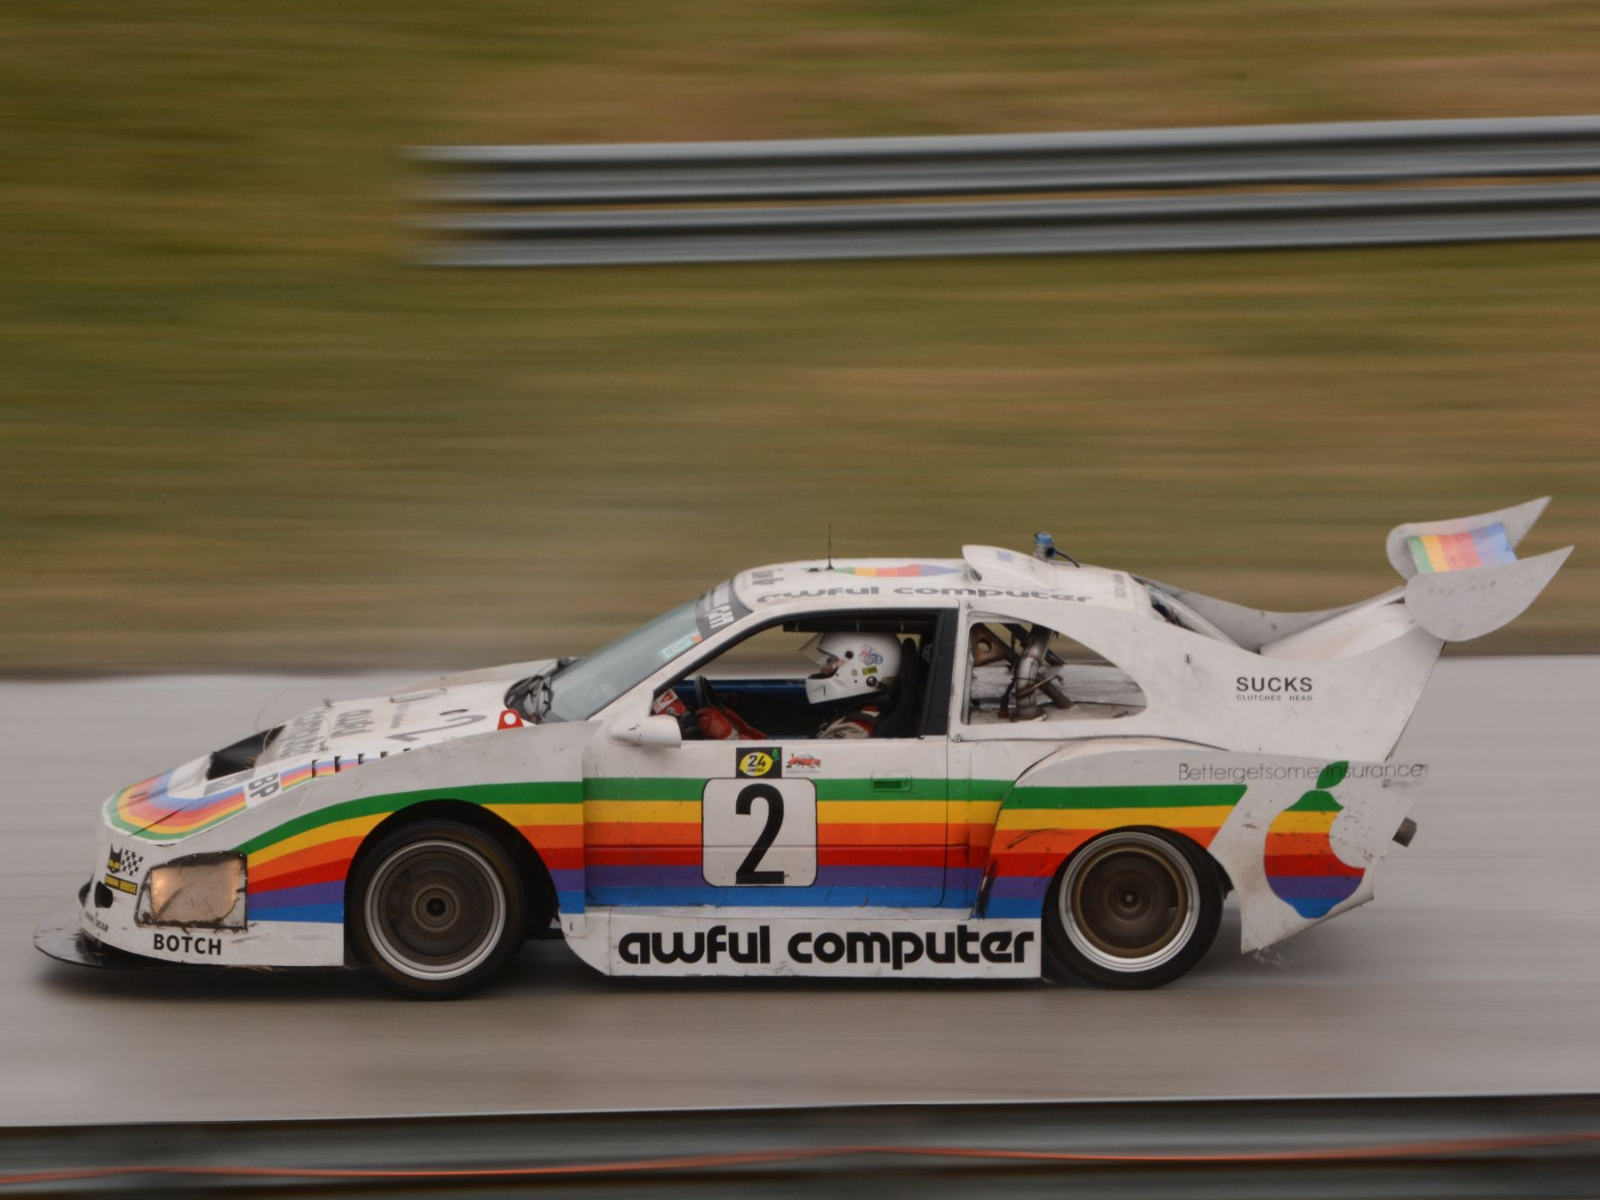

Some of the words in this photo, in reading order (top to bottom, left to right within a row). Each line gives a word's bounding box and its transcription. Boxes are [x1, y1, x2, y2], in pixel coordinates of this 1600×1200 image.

[893, 588, 1093, 602] computer
[1236, 676, 1313, 692] SUCKS
[748, 755, 766, 767] 24
[248, 772, 280, 798] BP
[735, 783, 785, 885] 2
[153, 933, 222, 956] BOTCH
[617, 925, 770, 964] awful
[787, 924, 1034, 970] computer
